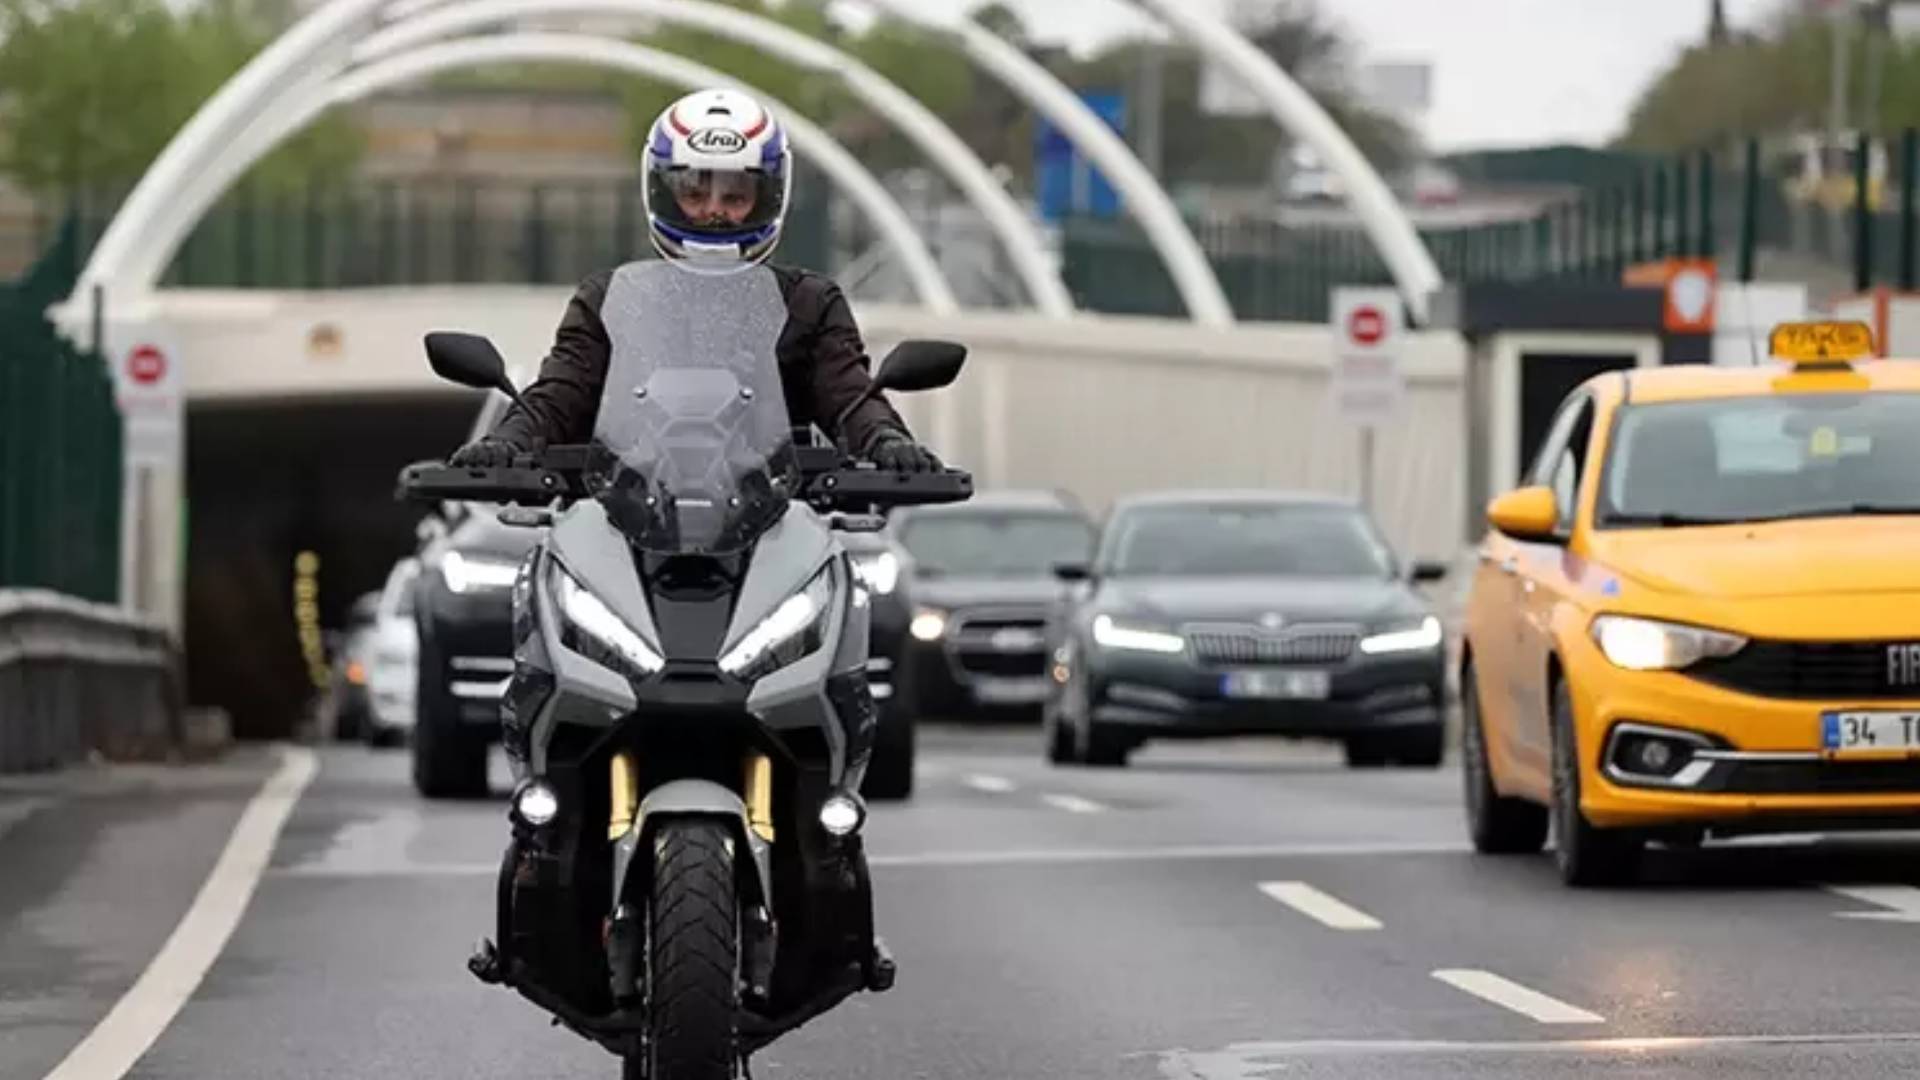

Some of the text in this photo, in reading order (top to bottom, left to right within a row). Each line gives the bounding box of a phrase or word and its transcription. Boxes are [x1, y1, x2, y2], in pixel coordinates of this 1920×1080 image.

[695, 129, 738, 146] Arai
[1844, 716, 1920, 745] 34 T
